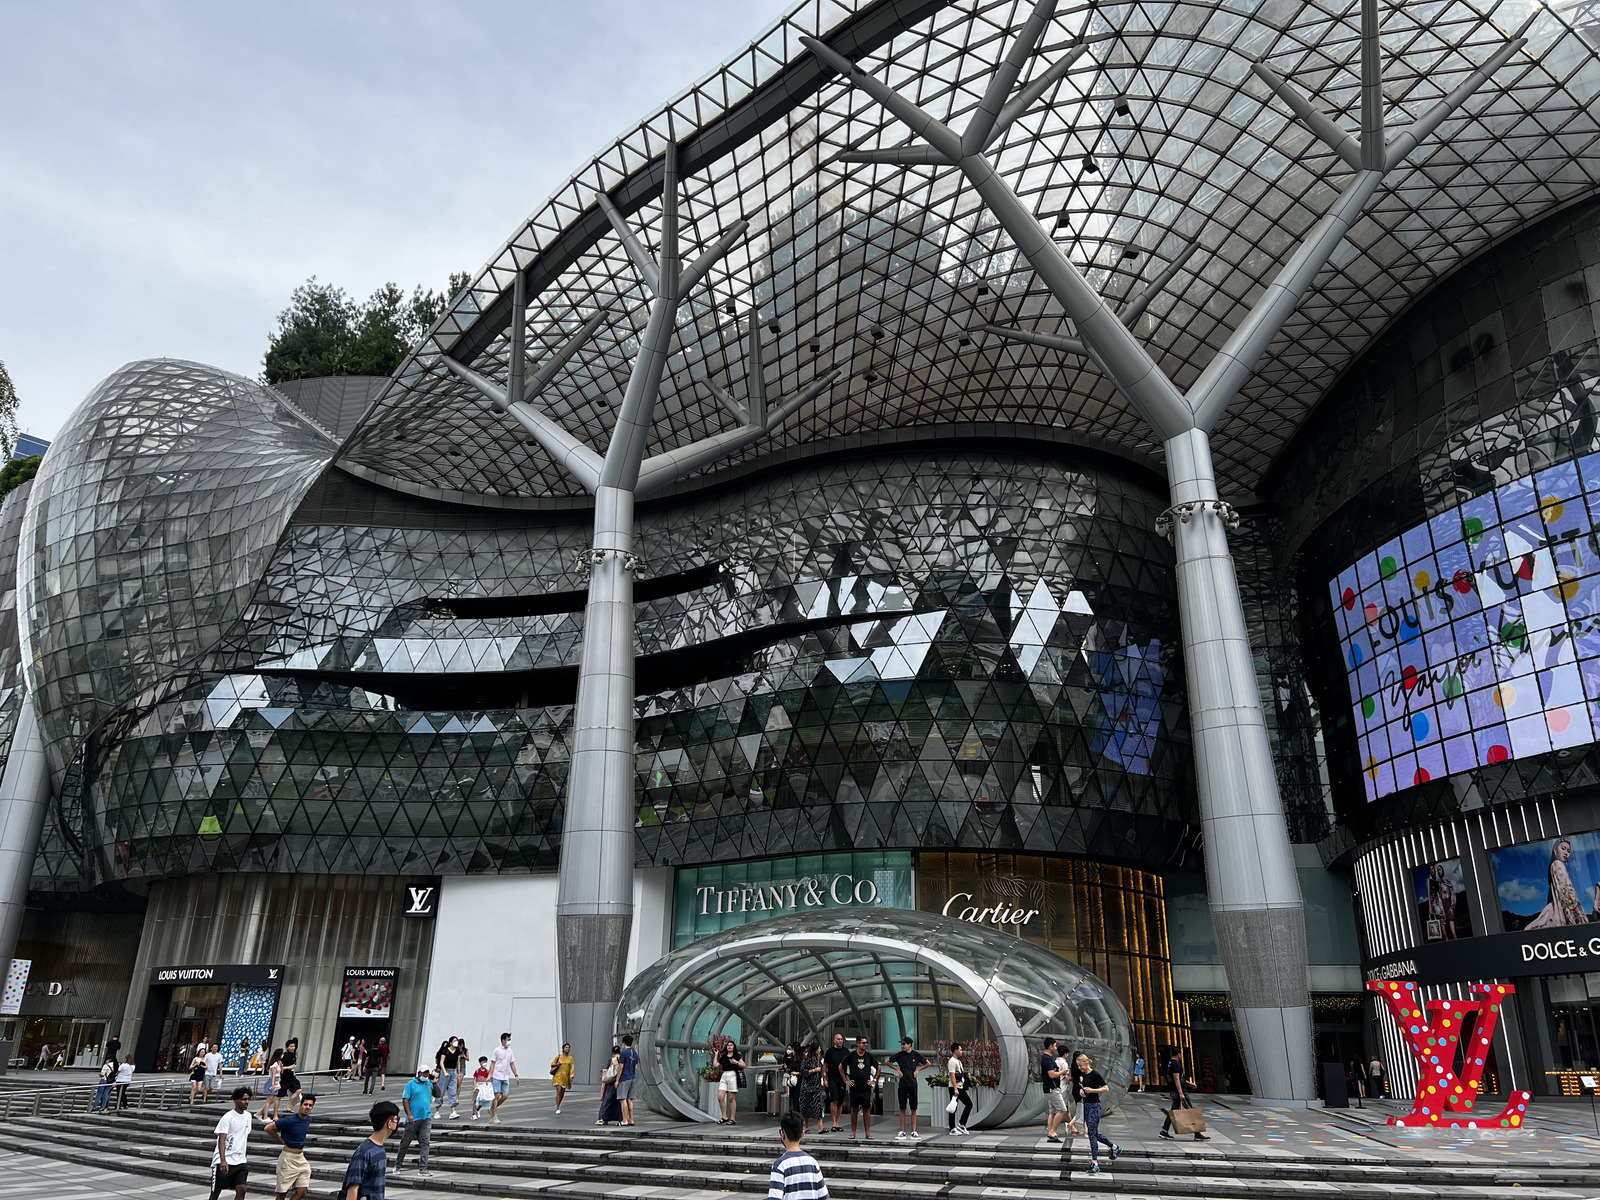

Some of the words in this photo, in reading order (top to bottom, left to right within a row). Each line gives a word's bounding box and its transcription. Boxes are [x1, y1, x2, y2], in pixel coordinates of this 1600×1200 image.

[1369, 577, 1455, 647] OUIS
[696, 886, 801, 915] TIFFANY
[942, 892, 1040, 925] Cartier
[1521, 939, 1578, 962] DOLCE
[1579, 946, 1588, 957] &
[158, 969, 178, 980] LOUIS
[178, 968, 214, 980] VUITTON
[366, 969, 395, 977] VUITTON
[1381, 960, 1417, 980] GABBANA
